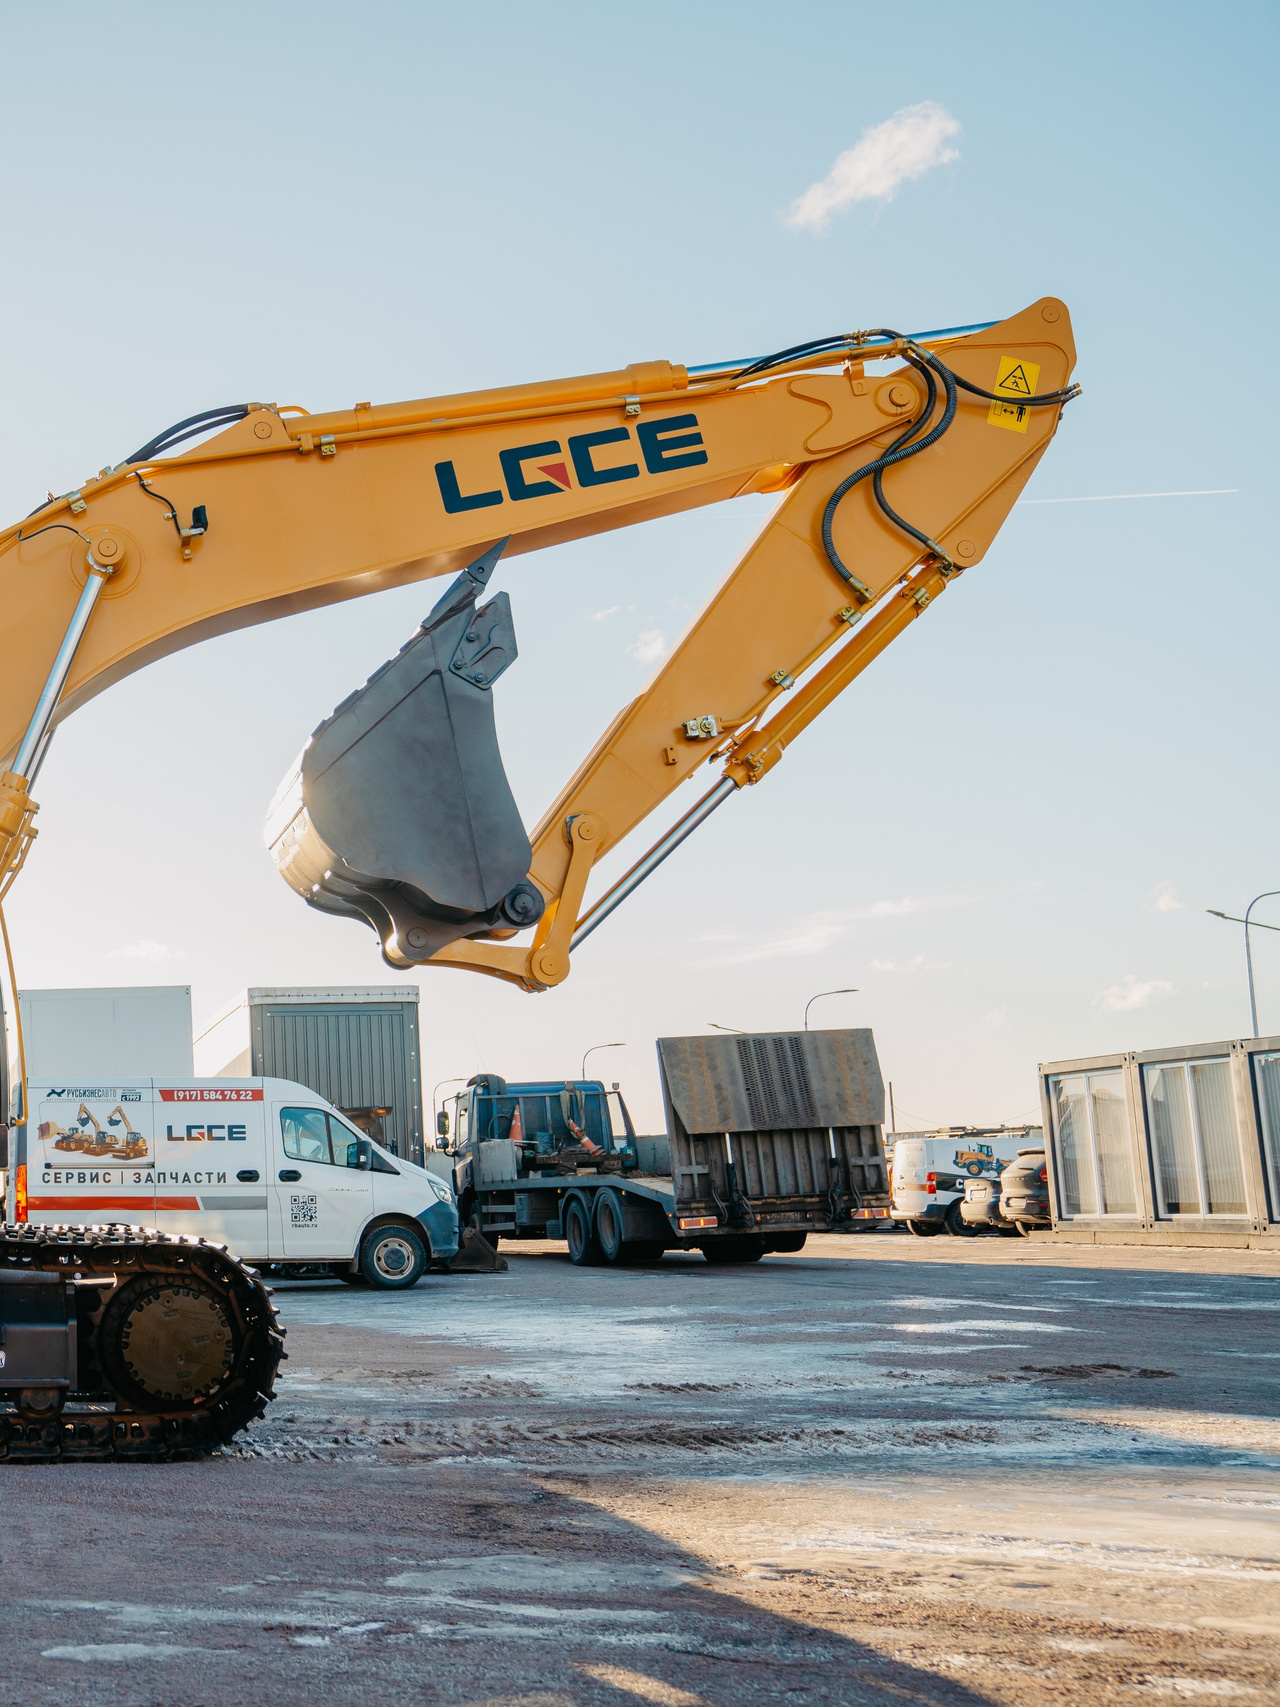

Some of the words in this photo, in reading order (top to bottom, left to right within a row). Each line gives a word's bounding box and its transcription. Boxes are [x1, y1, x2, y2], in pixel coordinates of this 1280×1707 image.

[434, 413, 709, 515] LGCE
[67, 1089, 117, 1098] РУСБИЗНЕСАВТО
[173, 1090, 201, 1101] (917)
[203, 1090, 222, 1100] 584
[224, 1090, 237, 1100] 76
[239, 1090, 253, 1100] 22
[166, 1124, 247, 1141] LGCE
[42, 1172, 112, 1184] СЕРВИС
[132, 1172, 227, 1184] ЗАПЧАСТИ
